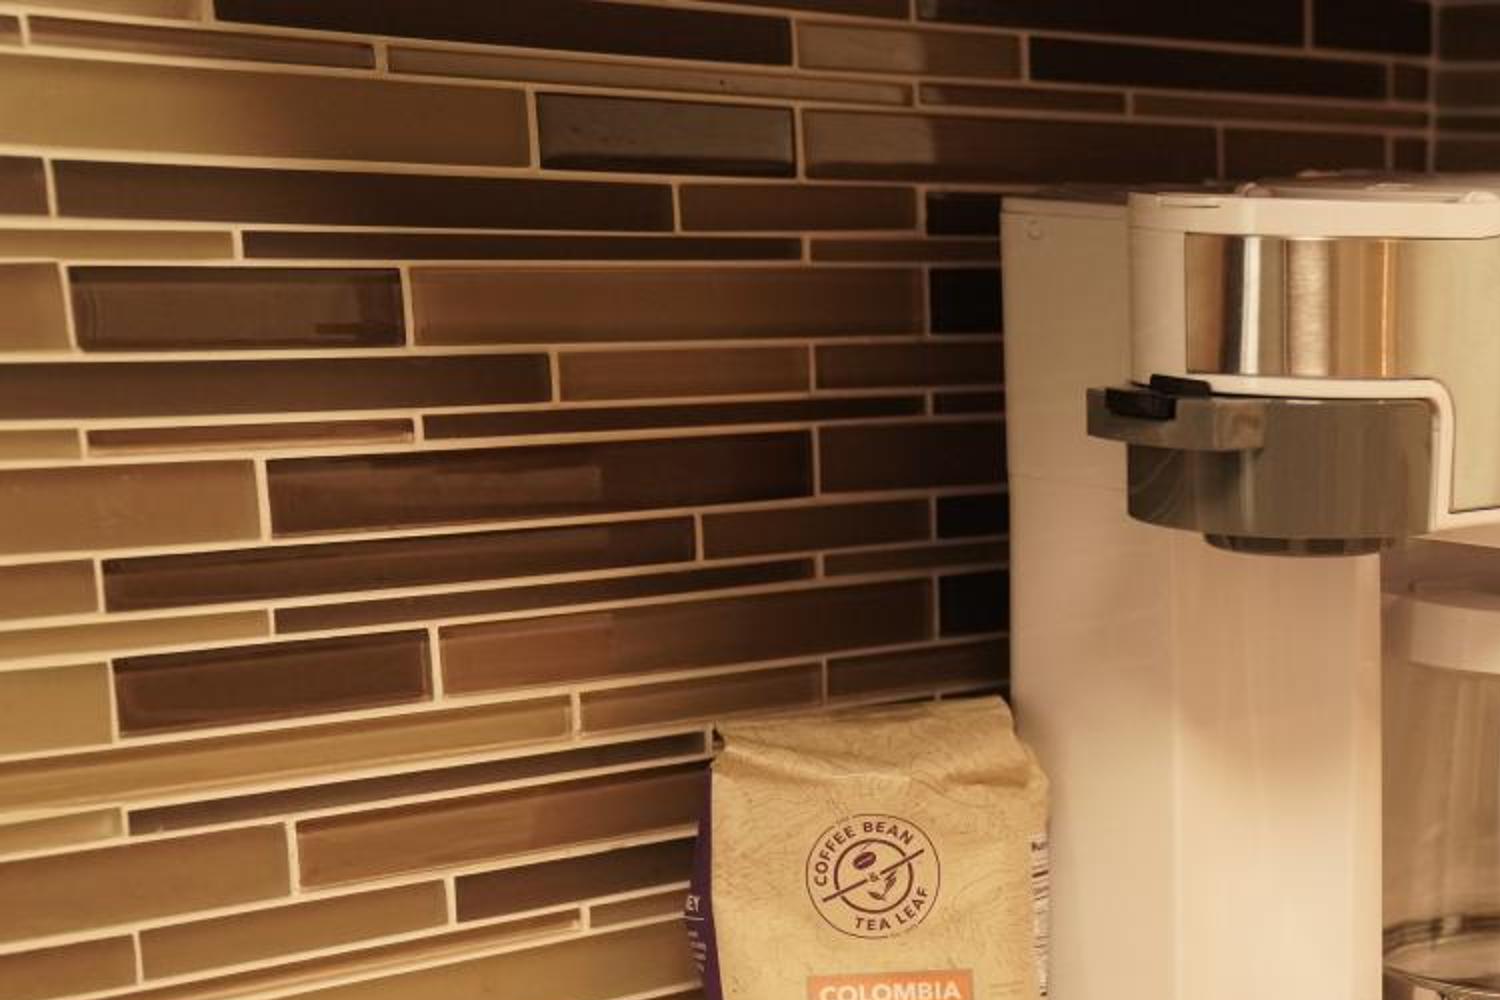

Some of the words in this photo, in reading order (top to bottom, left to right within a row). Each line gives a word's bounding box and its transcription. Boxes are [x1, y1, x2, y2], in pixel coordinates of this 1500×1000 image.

[813, 825, 857, 887] COFFEE
[863, 821, 914, 845] BEAN
[856, 917, 891, 931] TEA
[895, 886, 928, 924] LEAF
